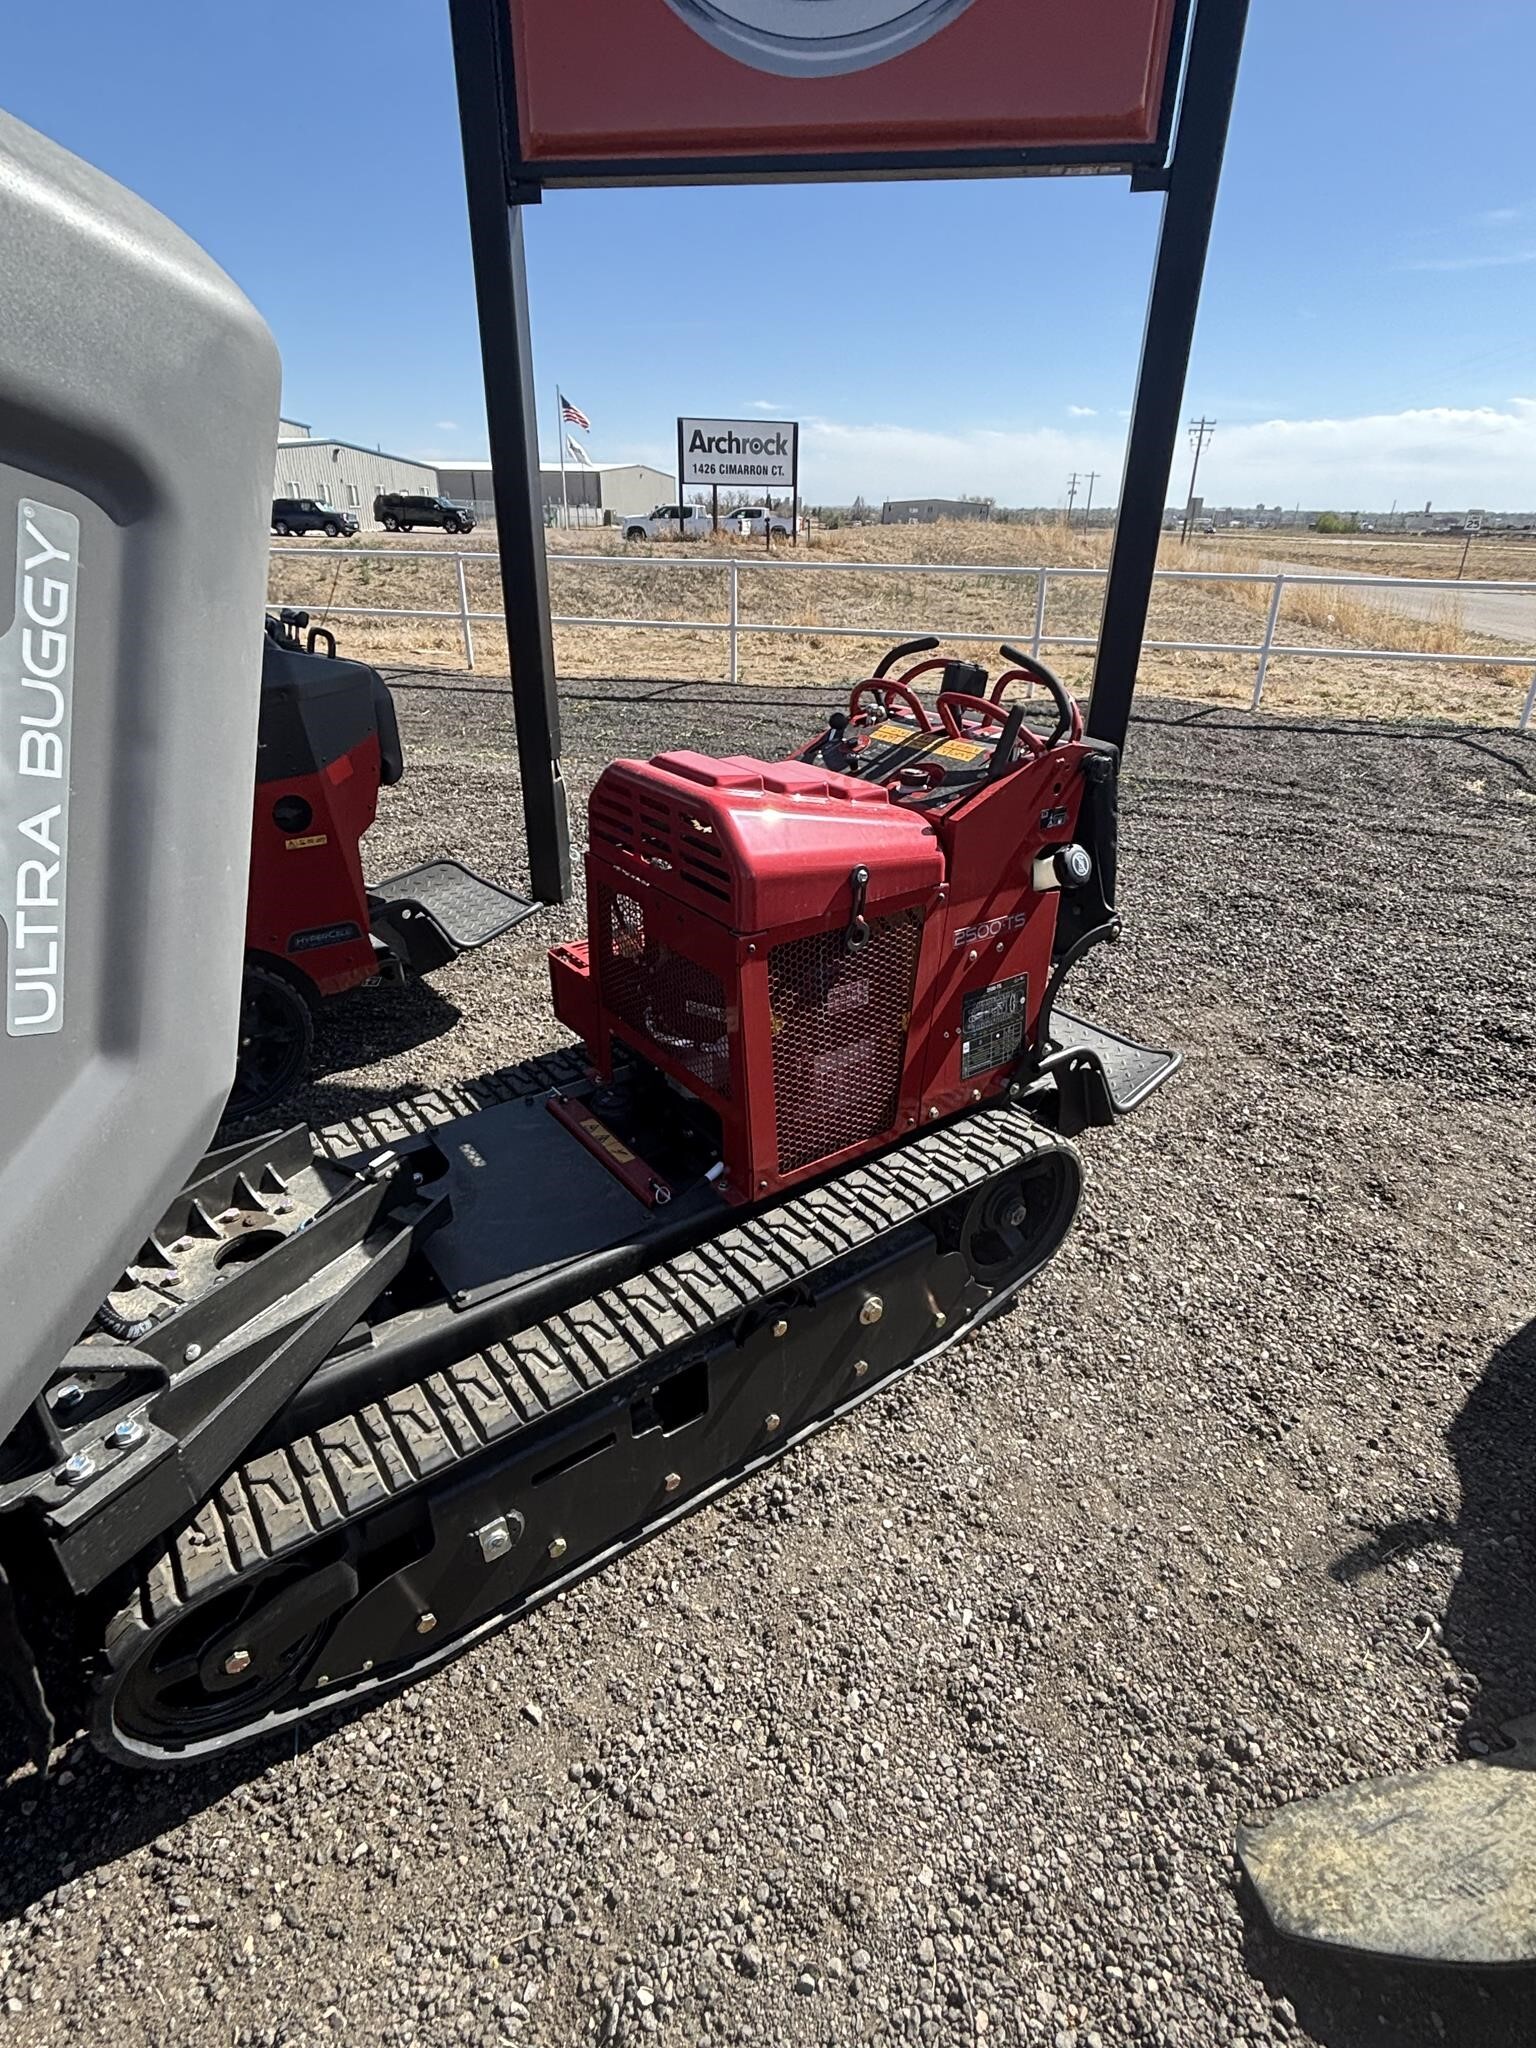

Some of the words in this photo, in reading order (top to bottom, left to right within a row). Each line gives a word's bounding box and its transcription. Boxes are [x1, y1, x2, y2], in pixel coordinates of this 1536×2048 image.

[688, 429, 788, 456] Archrock
[692, 463, 716, 475] 1426
[719, 464, 768, 476] CIMARRON
[771, 465, 785, 477] CT.
[1466, 520, 1480, 529] 25
[14, 804, 62, 1026] ULTRA
